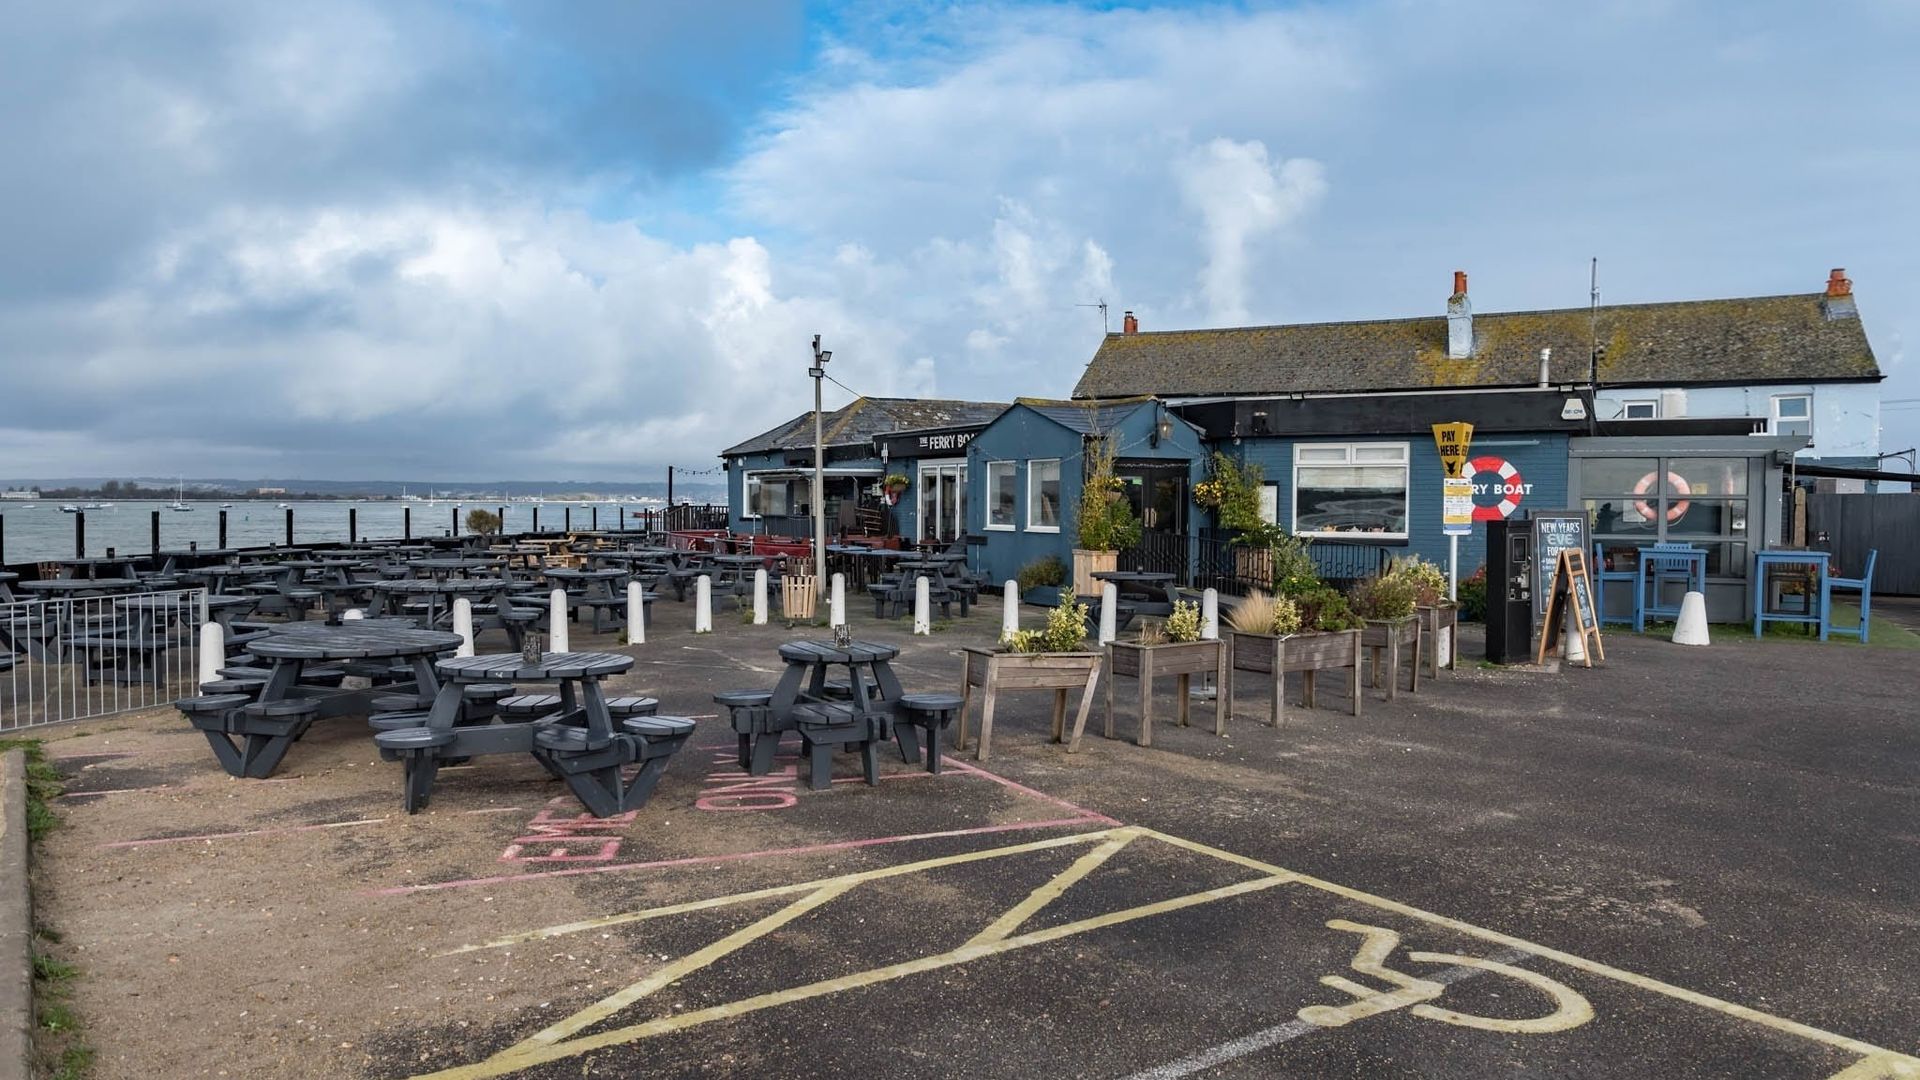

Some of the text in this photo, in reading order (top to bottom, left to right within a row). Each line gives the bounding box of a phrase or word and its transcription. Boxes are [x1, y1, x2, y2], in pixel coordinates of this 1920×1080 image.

[929, 434, 955, 450] FERRY
[957, 433, 975, 448] BO
[1442, 430, 1455, 442] PAY
[1440, 444, 1460, 457] HERE
[1471, 484, 1533, 495] RY BOAT
[1541, 522, 1580, 533] NEW YEAR'S
[1547, 533, 1574, 545] EVE
